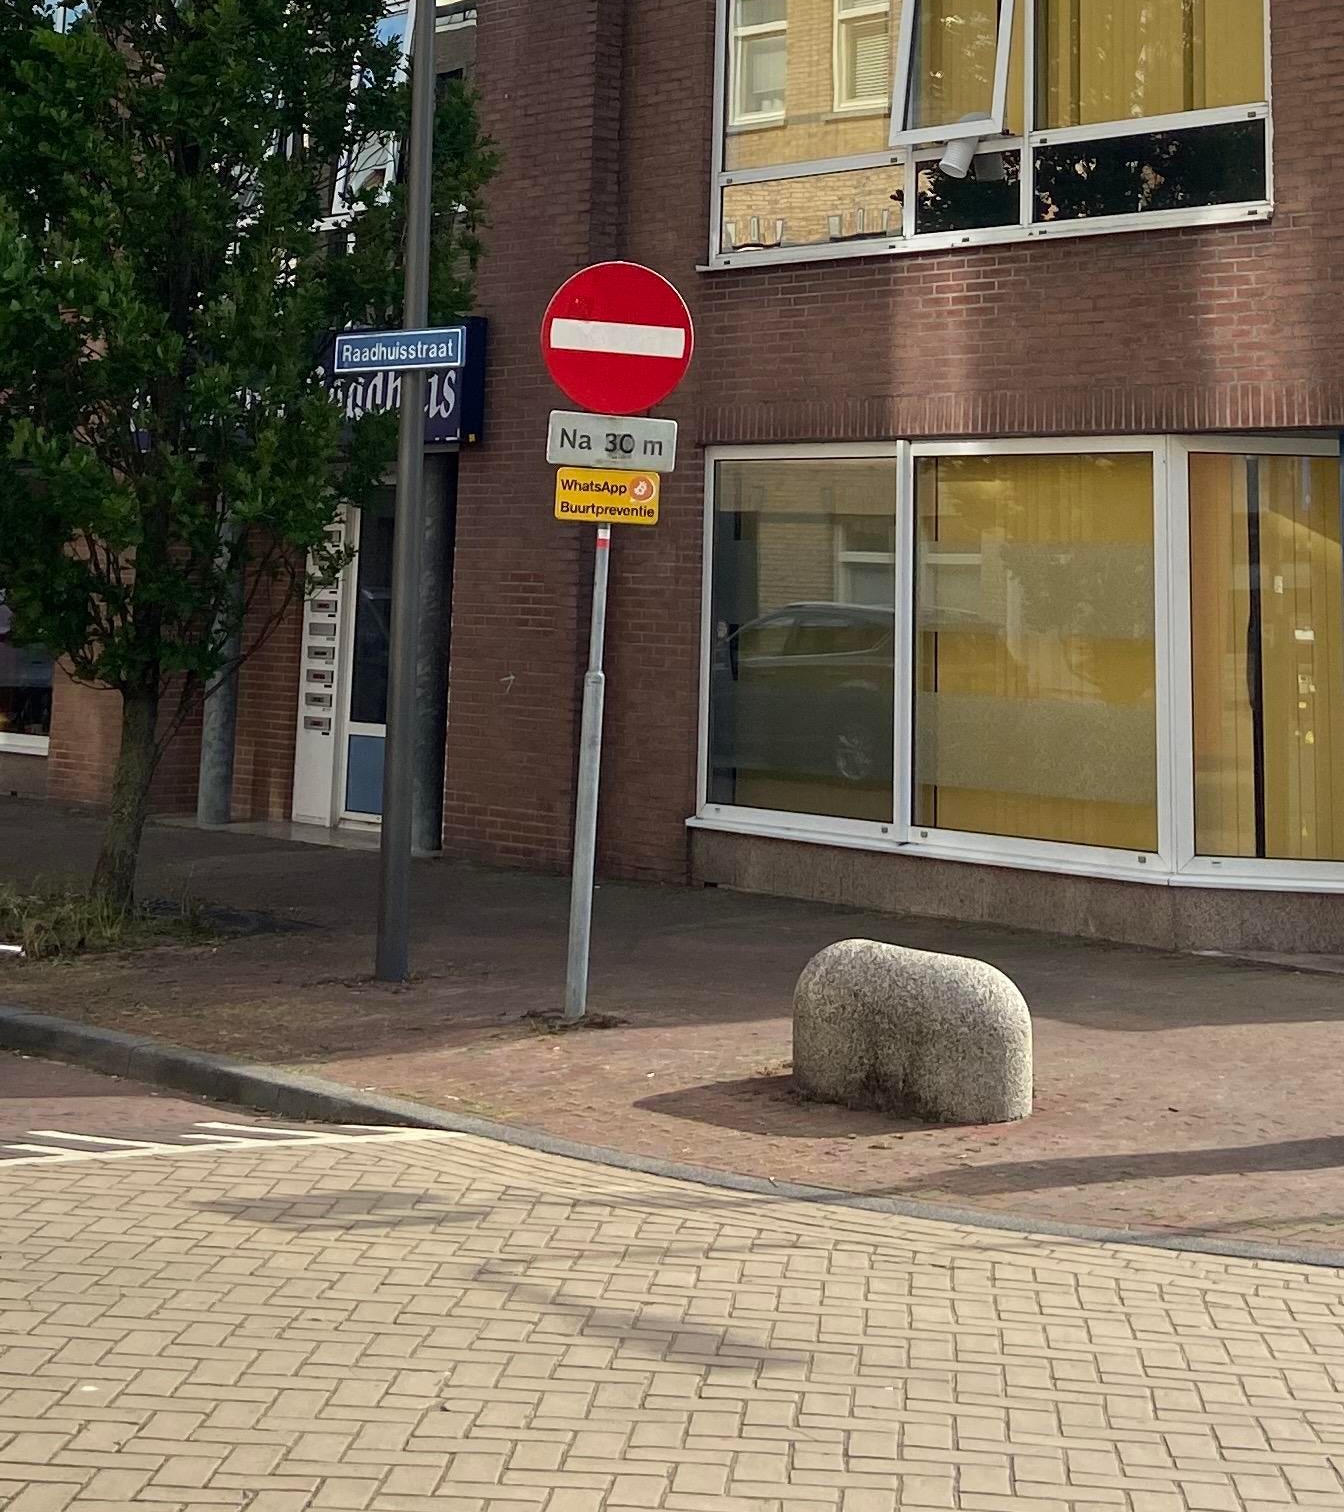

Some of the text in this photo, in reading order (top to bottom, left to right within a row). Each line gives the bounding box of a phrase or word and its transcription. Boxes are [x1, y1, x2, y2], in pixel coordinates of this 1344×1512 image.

[342, 338, 453, 363] Raadhuisstraat
[559, 427, 663, 456] Na 30 m
[560, 479, 628, 496] WhatsApp
[560, 501, 655, 518] Buurtpreventie
